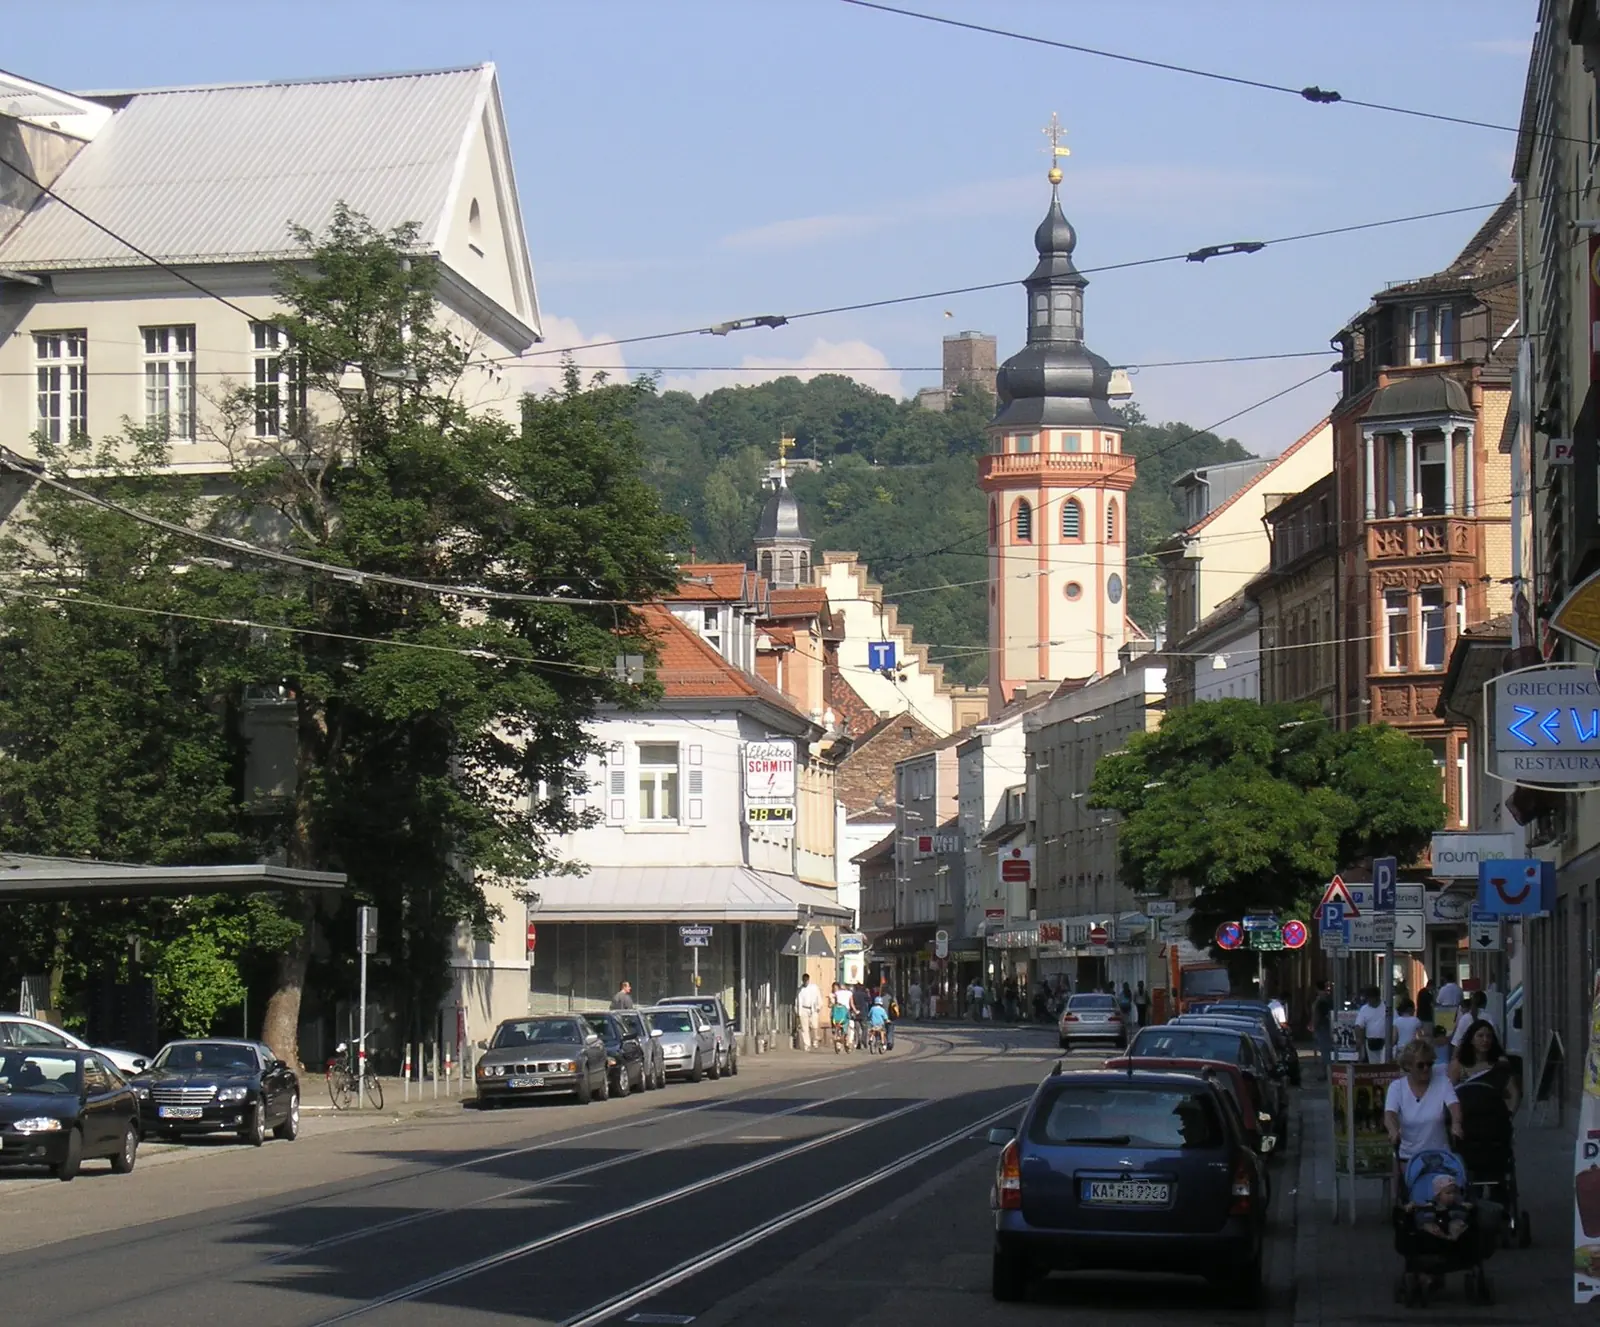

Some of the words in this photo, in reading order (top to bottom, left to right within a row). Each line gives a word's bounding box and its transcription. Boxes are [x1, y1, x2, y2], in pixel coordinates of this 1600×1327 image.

[748, 744, 792, 760] Elektro
[749, 761, 792, 772] SCHMITT
[1378, 866, 1391, 905] P
[1327, 907, 1338, 928] P
